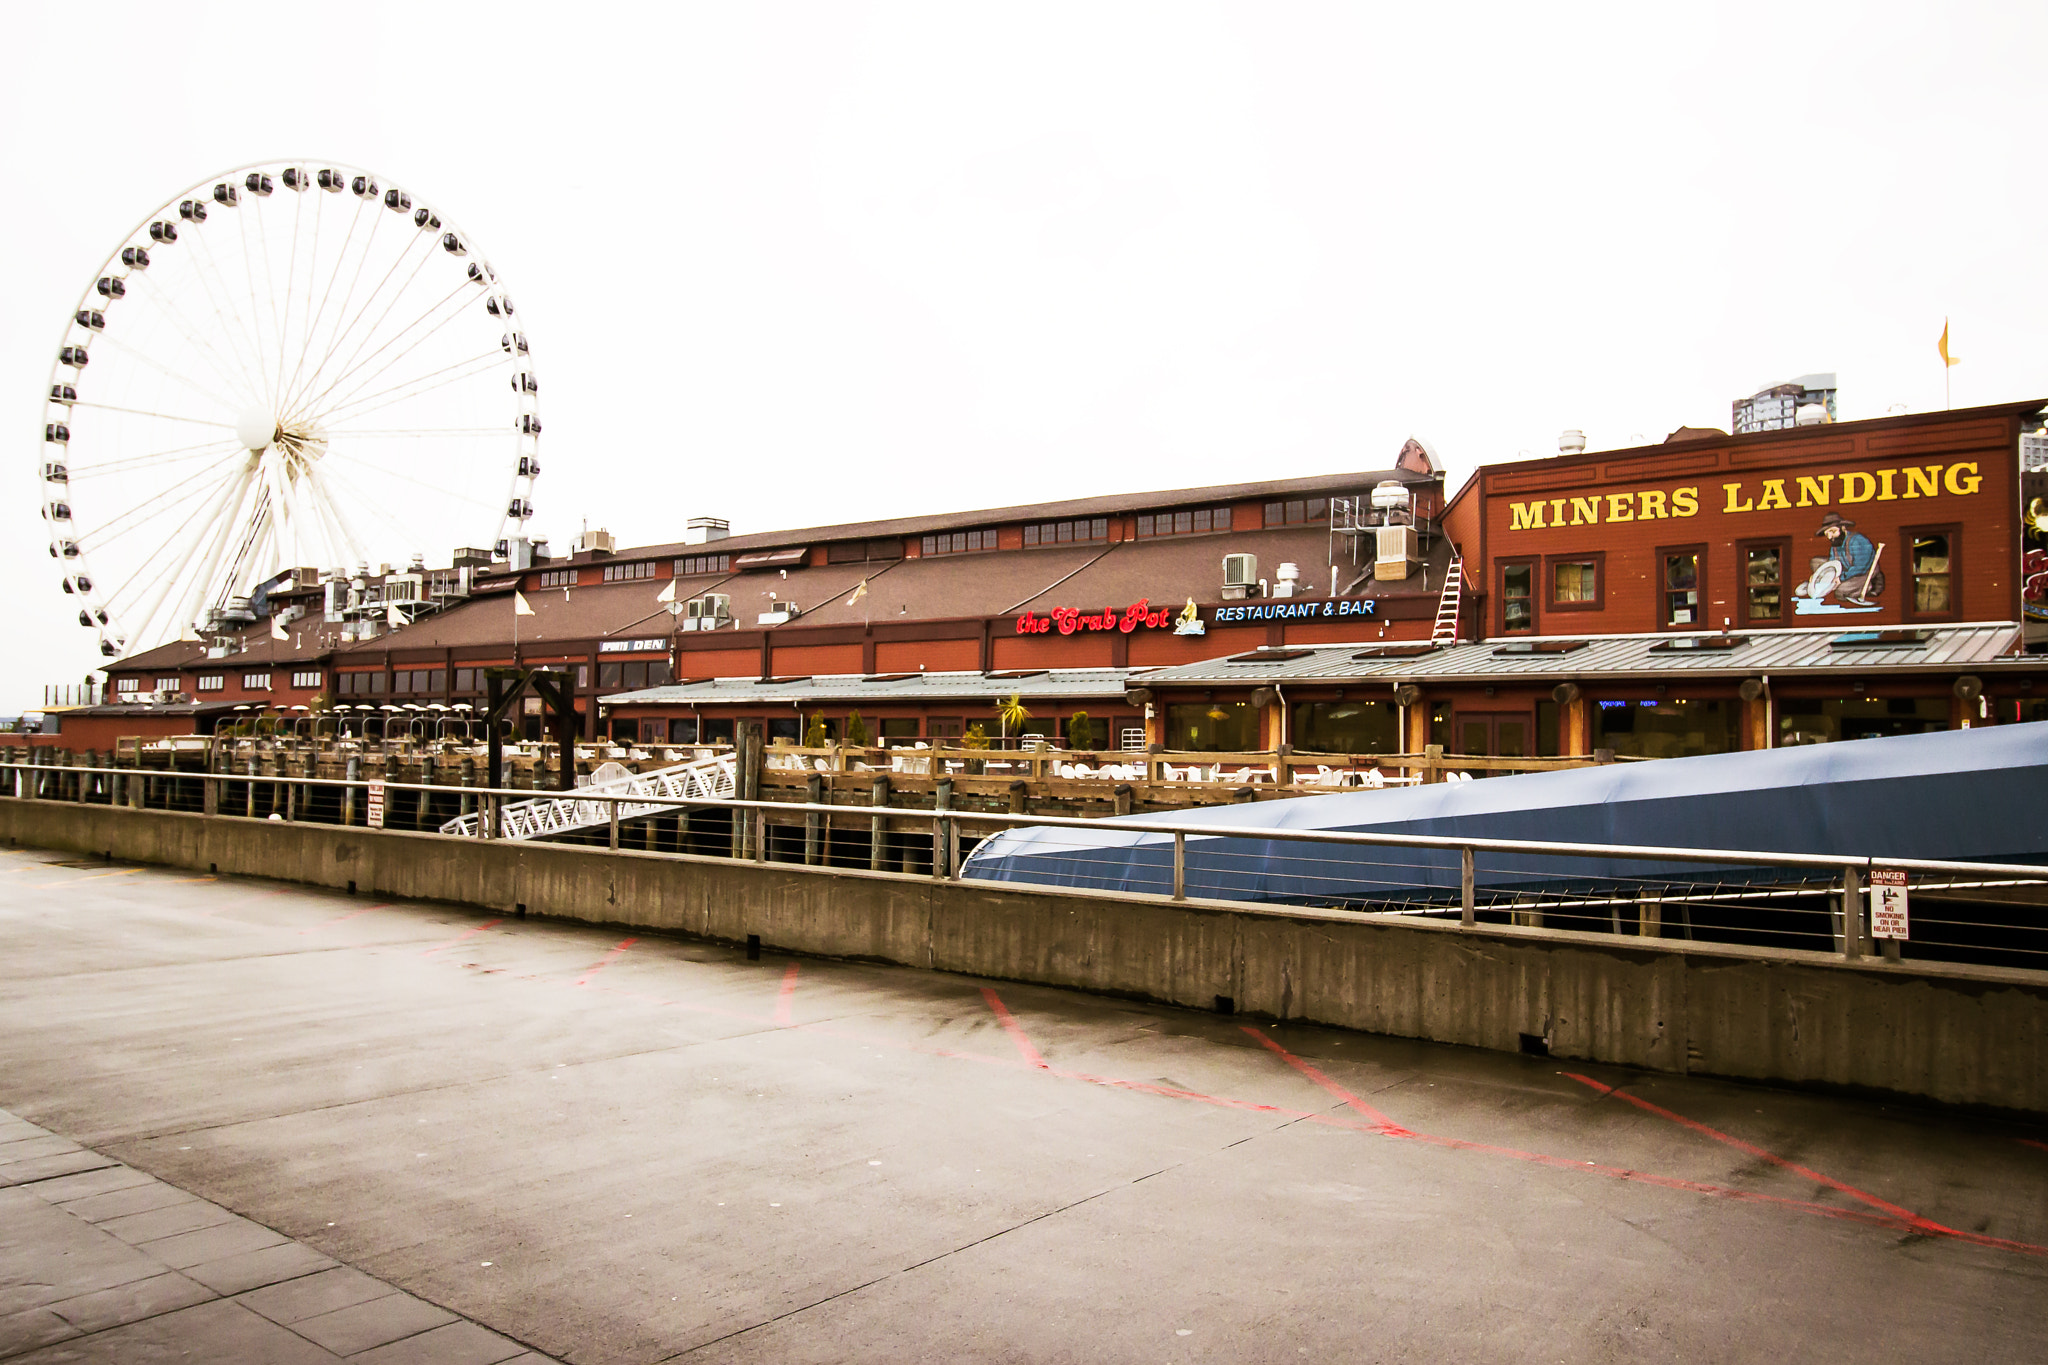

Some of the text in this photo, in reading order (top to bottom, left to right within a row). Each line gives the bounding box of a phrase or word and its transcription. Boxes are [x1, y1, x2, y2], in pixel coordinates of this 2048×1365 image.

[1509, 462, 1983, 531] MINERS LANDING
[1016, 598, 1170, 635] the Crab Pot
[1215, 600, 1375, 621] RESTAURANT & BAR
[633, 640, 663, 650] DEN
[1871, 871, 1905, 880] DANGER
[1875, 912, 1904, 920] SMOKING
